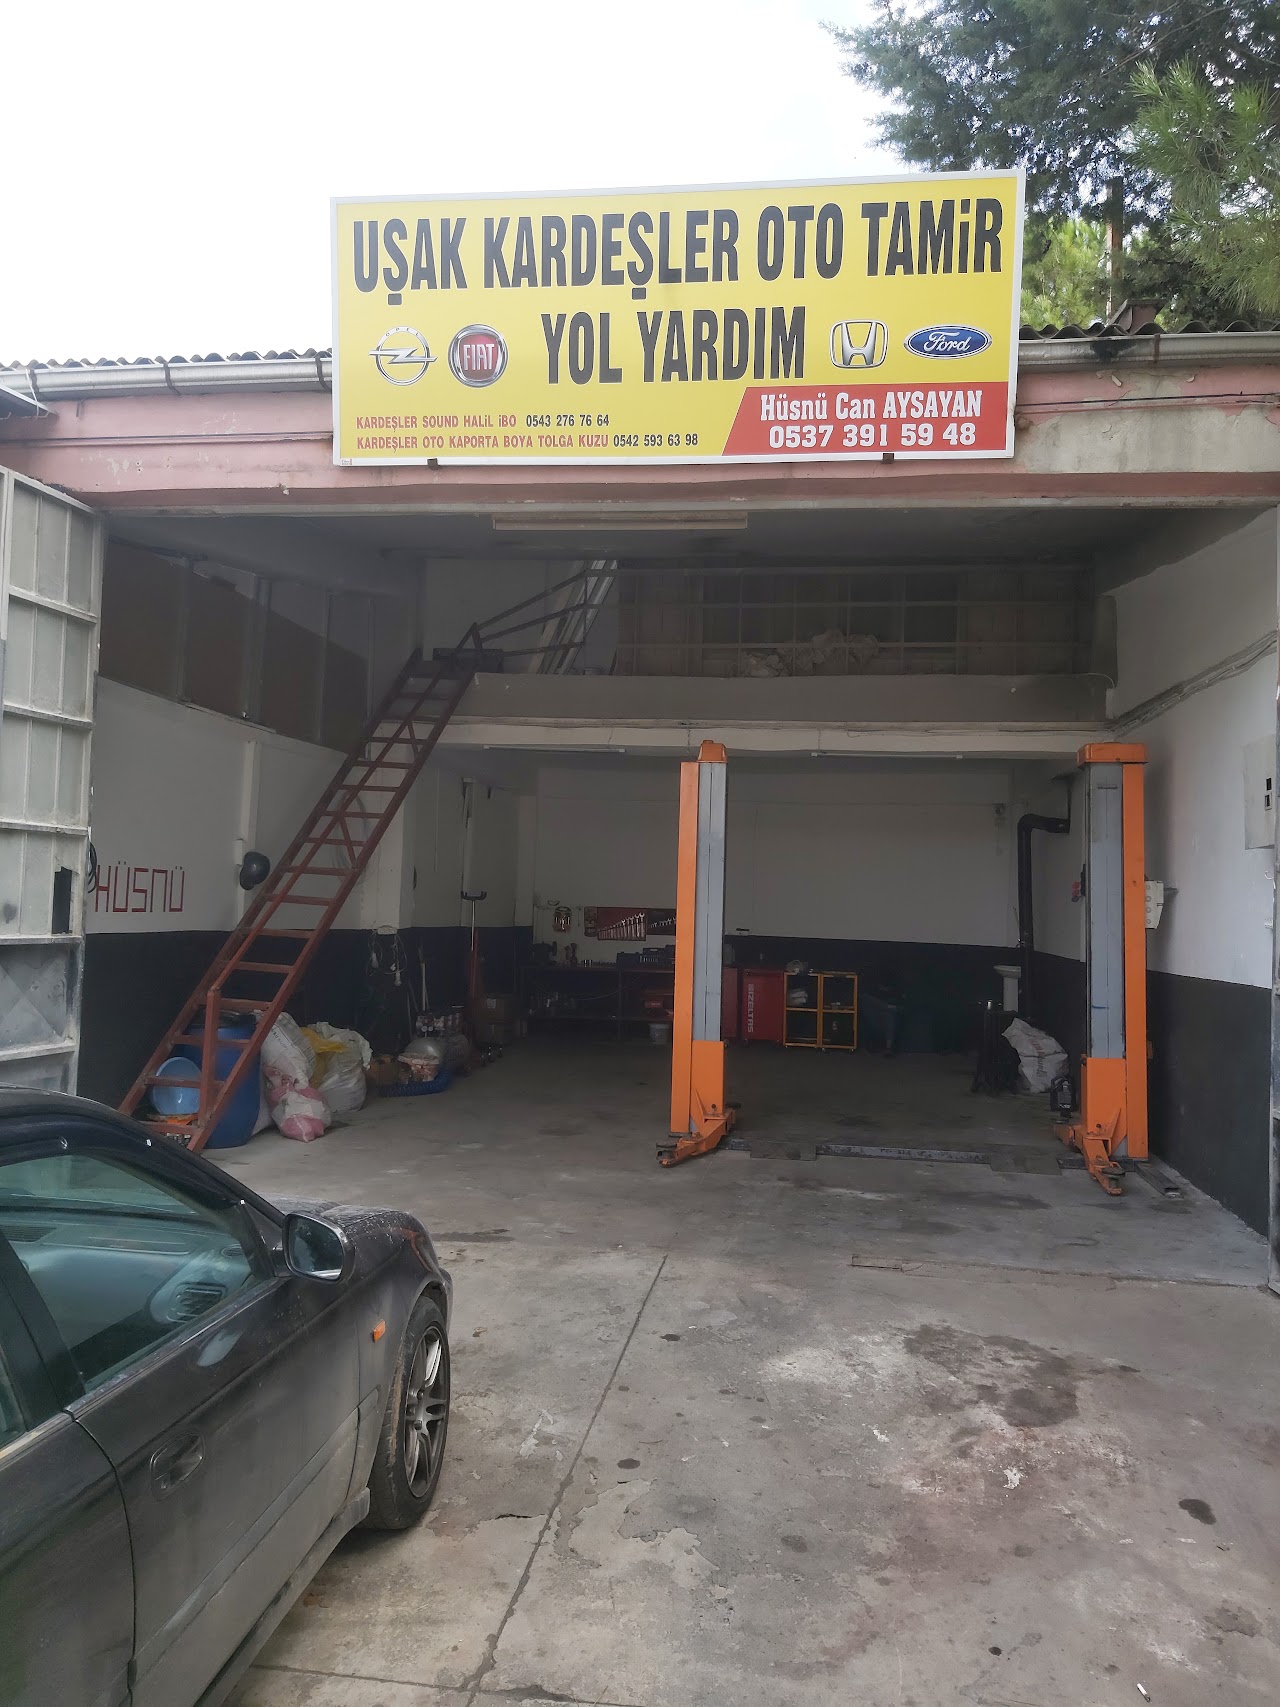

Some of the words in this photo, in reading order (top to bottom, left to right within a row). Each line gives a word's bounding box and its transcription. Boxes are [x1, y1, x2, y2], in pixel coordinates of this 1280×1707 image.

[353, 217, 468, 306] UŞAK
[484, 208, 739, 300] KARDEŞLER
[757, 202, 844, 281] OTO
[540, 311, 623, 385] YOL
[636, 305, 806, 383] YARDIM
[923, 330, 972, 353] Ford
[463, 343, 495, 371] FIAT
[760, 392, 828, 421] Hüsnü
[835, 392, 876, 420] Can
[883, 390, 983, 419] AYSAYAN
[356, 415, 418, 432] KARDEŞLER
[422, 415, 459, 428] SOUND
[526, 414, 551, 427] 0543
[556, 414, 575, 427] 276
[579, 414, 592, 427] 76
[596, 414, 610, 426] 64
[769, 425, 834, 449] 0537
[842, 424, 887, 447] 391
[900, 423, 934, 447] 59
[942, 422, 976, 446] 48
[357, 436, 418, 453] KARDEŞLER
[422, 436, 444, 449] OTO
[449, 435, 499, 449] KAPORTA
[503, 435, 533, 448] BOYA
[538, 434, 574, 448] TOLGA
[578, 434, 609, 447] KUZU
[613, 434, 639, 447] 0542
[643, 434, 663, 447] 593
[667, 433, 681, 447] 63
[685, 433, 698, 446] 98
